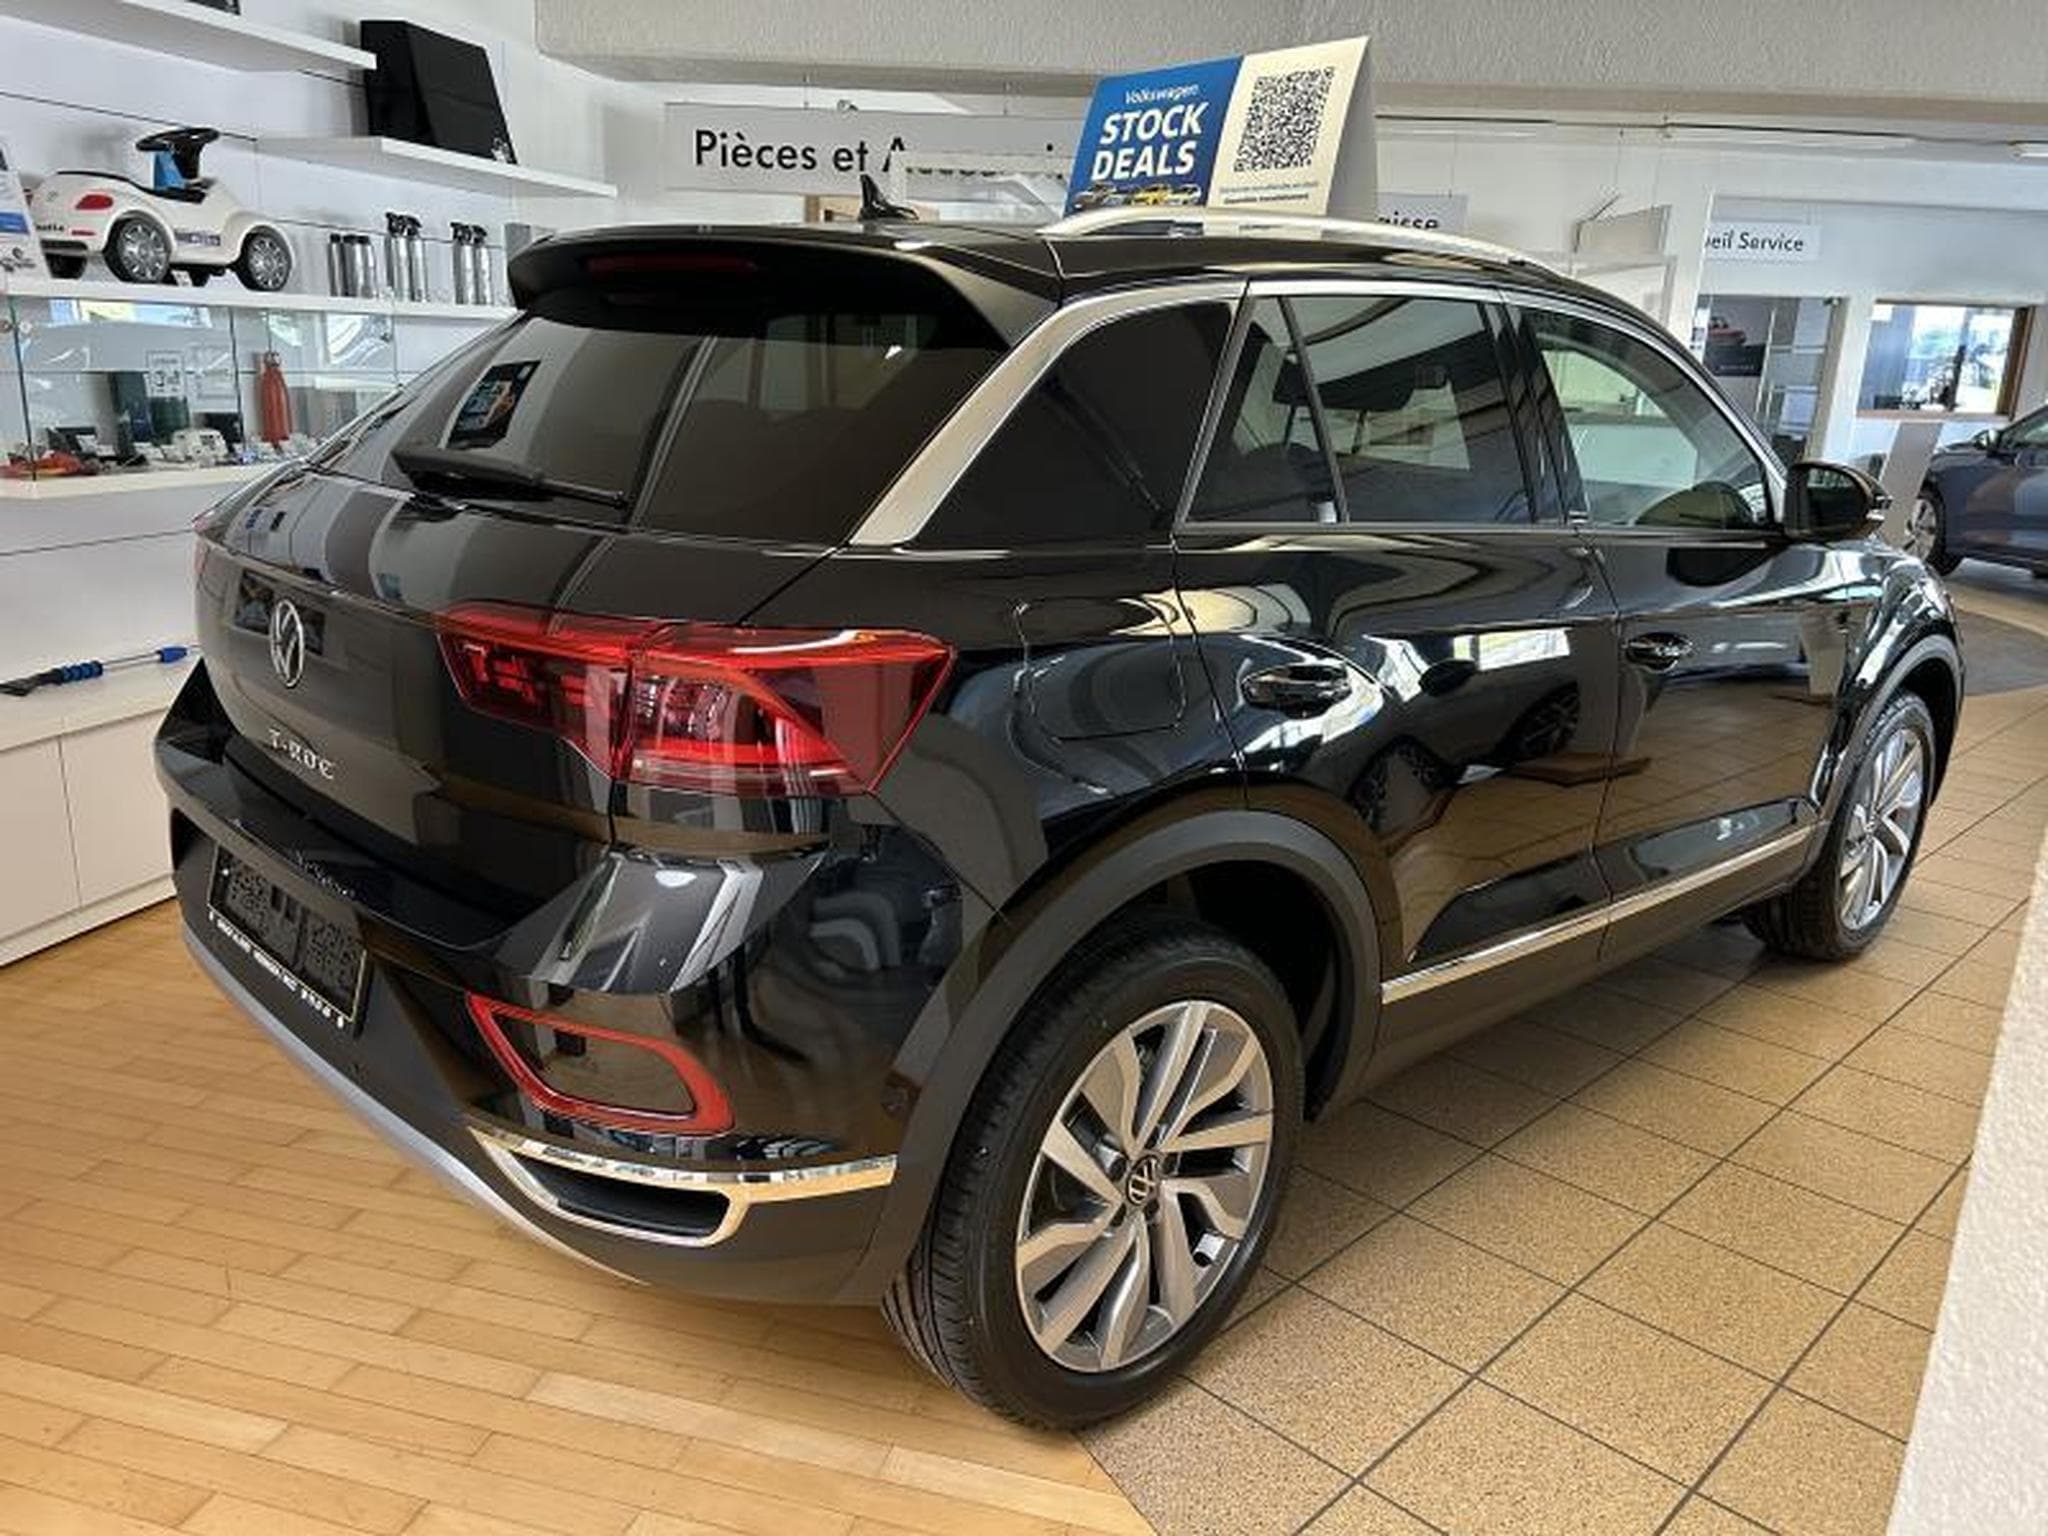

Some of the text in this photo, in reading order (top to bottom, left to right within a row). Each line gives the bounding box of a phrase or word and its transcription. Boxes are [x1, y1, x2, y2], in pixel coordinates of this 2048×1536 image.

[1124, 84, 1199, 104] Volkswagen
[1100, 102, 1208, 145] STOCK
[695, 129, 818, 170] Pièces
[832, 140, 868, 172] et
[1091, 140, 1196, 181] DEALS
[1738, 231, 1804, 252] Service
[268, 728, 334, 780] T-ROC
